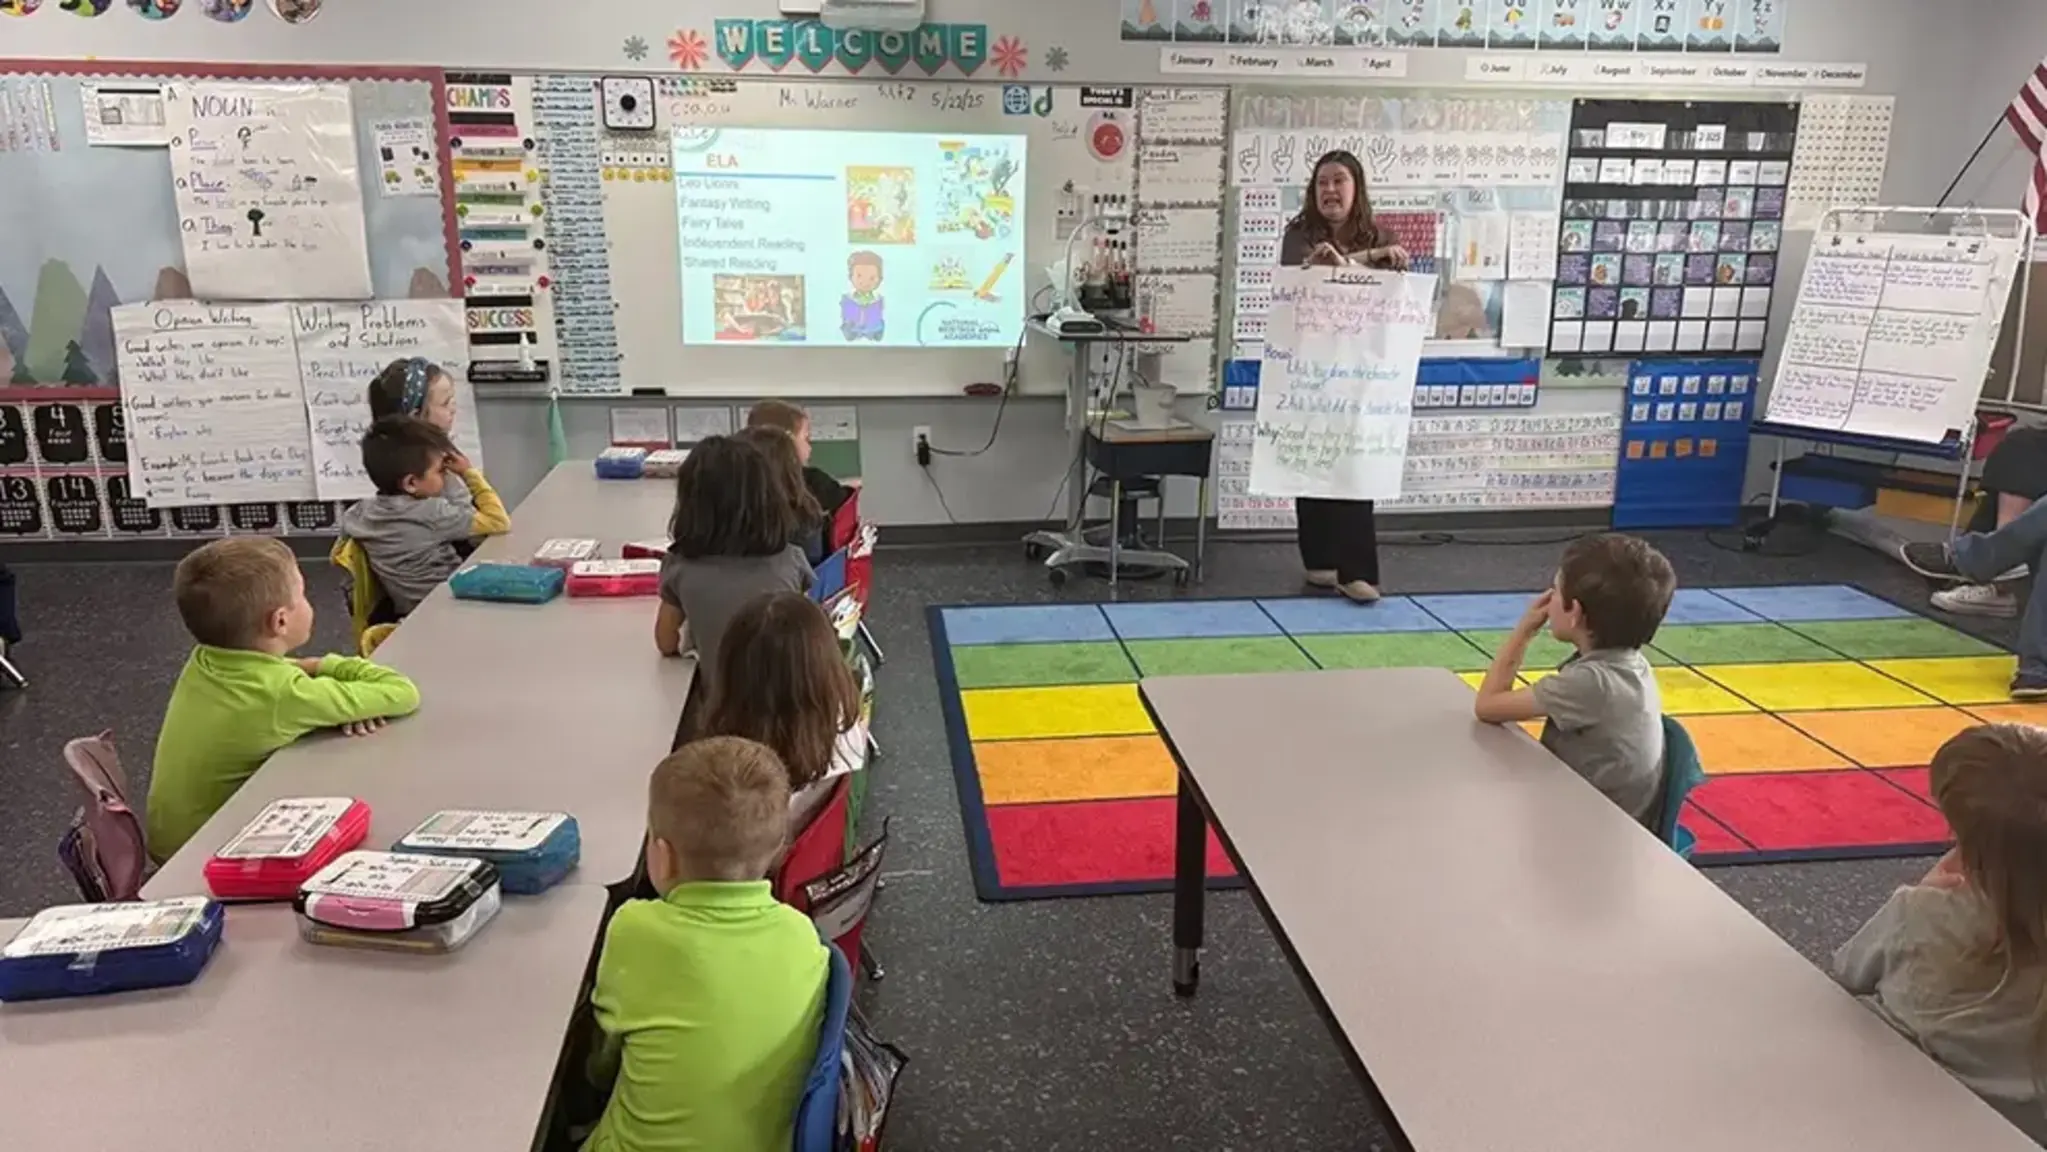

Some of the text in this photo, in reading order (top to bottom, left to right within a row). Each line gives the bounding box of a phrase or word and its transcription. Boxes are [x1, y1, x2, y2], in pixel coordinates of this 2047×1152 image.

[723, 26, 977, 57] WELCOME
[1176, 56, 1391, 69] January February March April
[1600, 65, 1631, 76] August
[1651, 65, 1696, 78] September
[1712, 67, 1747, 78] October
[1765, 69, 1807, 80] November
[1820, 69, 1862, 80] December
[447, 87, 510, 108] CHAMPS
[805, 88, 858, 109] Warner
[932, 84, 984, 111] 5/22/25
[192, 96, 252, 117] NOUN
[1241, 100, 1383, 129] NUMBER
[706, 154, 738, 168] ELA
[679, 176, 701, 188] Leo
[680, 196, 726, 211] Fantasy
[682, 216, 711, 230] Fairy
[683, 236, 805, 252] Independent Reading
[684, 256, 777, 271] Shared Reading
[1331, 267, 1374, 282] Lesson
[209, 308, 252, 325] Writing
[296, 303, 426, 333] Writing Problems
[467, 309, 533, 328] SUCCESS
[328, 332, 418, 349] and Solutions
[311, 361, 345, 378] Pencil
[131, 395, 156, 410] Good
[51, 406, 66, 427] 4
[49, 428, 72, 437] Four
[59, 477, 86, 500] 14
[51, 499, 98, 507] Fourteen
